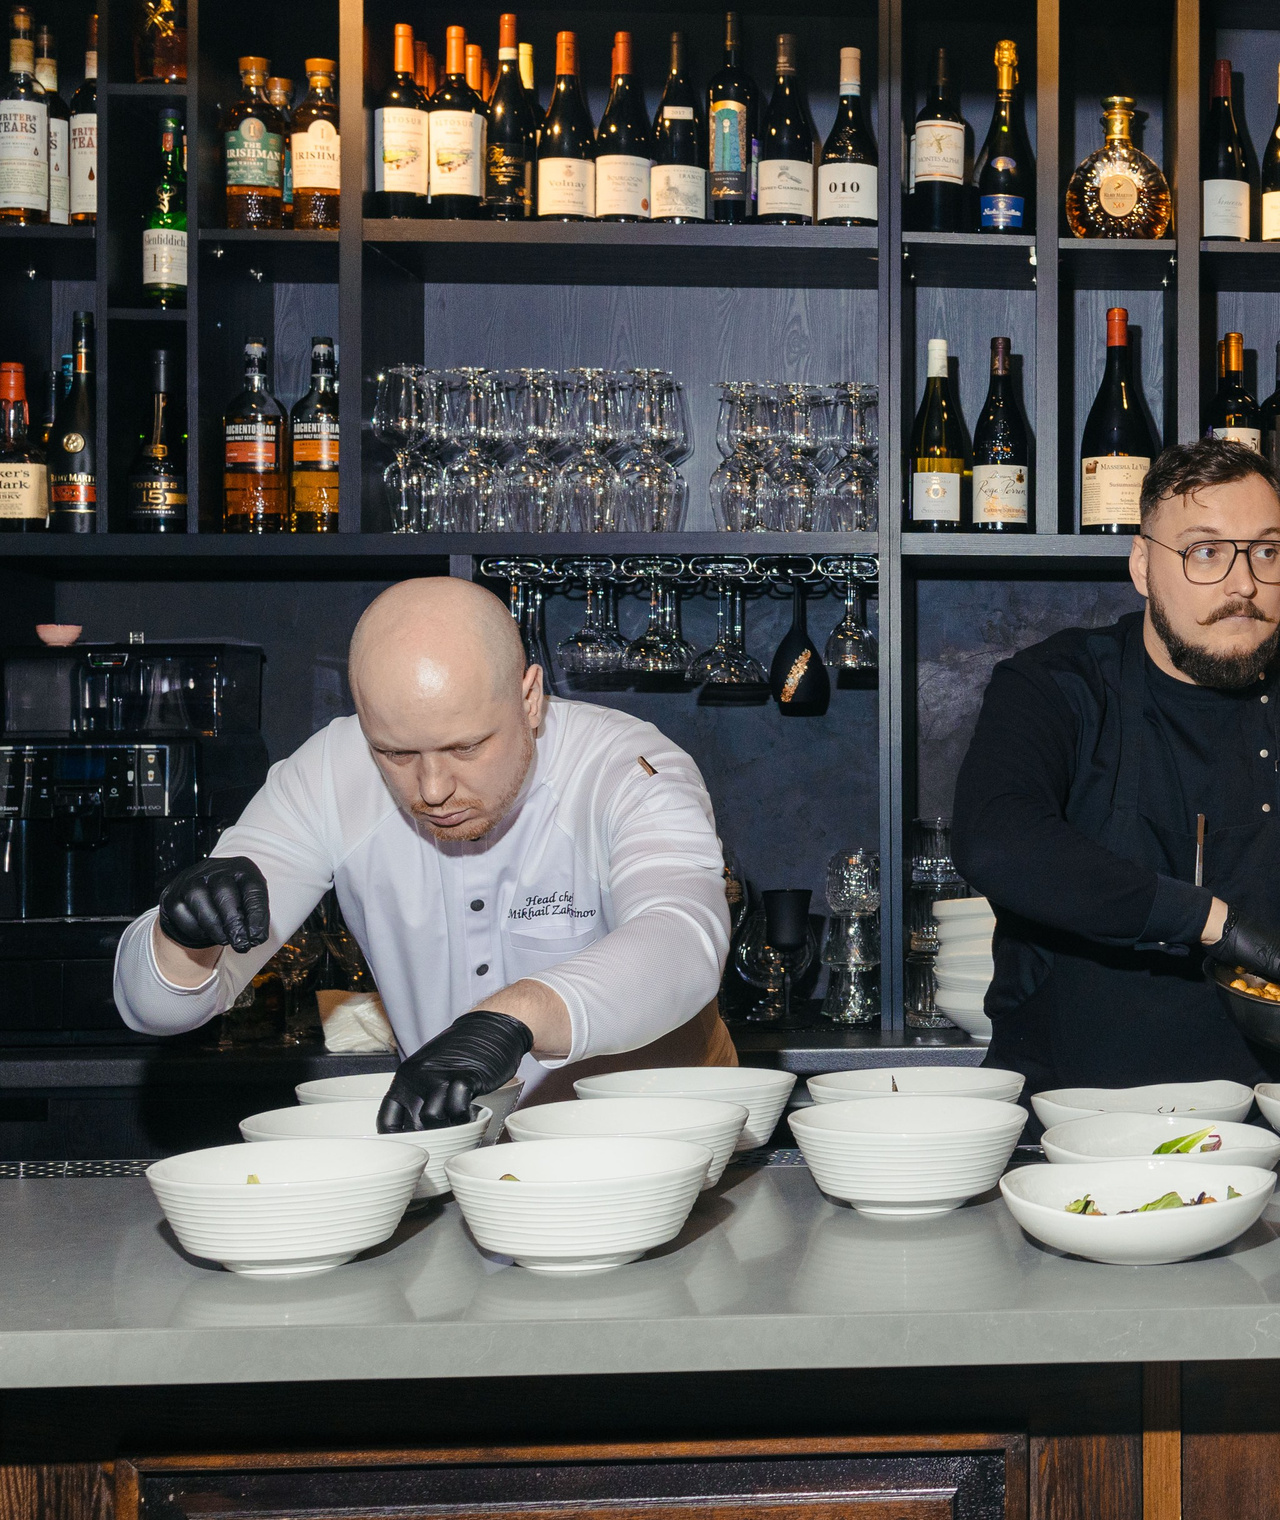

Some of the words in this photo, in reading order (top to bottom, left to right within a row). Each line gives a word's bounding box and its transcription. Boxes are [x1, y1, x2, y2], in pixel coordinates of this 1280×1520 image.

[71, 137, 95, 149] TEA
[227, 147, 280, 161] IRISHMAN
[295, 151, 339, 162] IRISHM
[942, 156, 960, 164] ALPHA
[549, 180, 587, 190] Volnay
[829, 181, 860, 193] 010
[145, 233, 186, 247] Glenfiddich
[226, 423, 276, 435] AUCHENTOSHAN
[294, 422, 339, 433] AUCHENTOSHA
[132, 481, 178, 489] TORRES
[1001, 480, 1027, 496] Perrin
[142, 489, 165, 504] 15
[526, 891, 558, 906] Head
[507, 904, 551, 920] Mikhail
